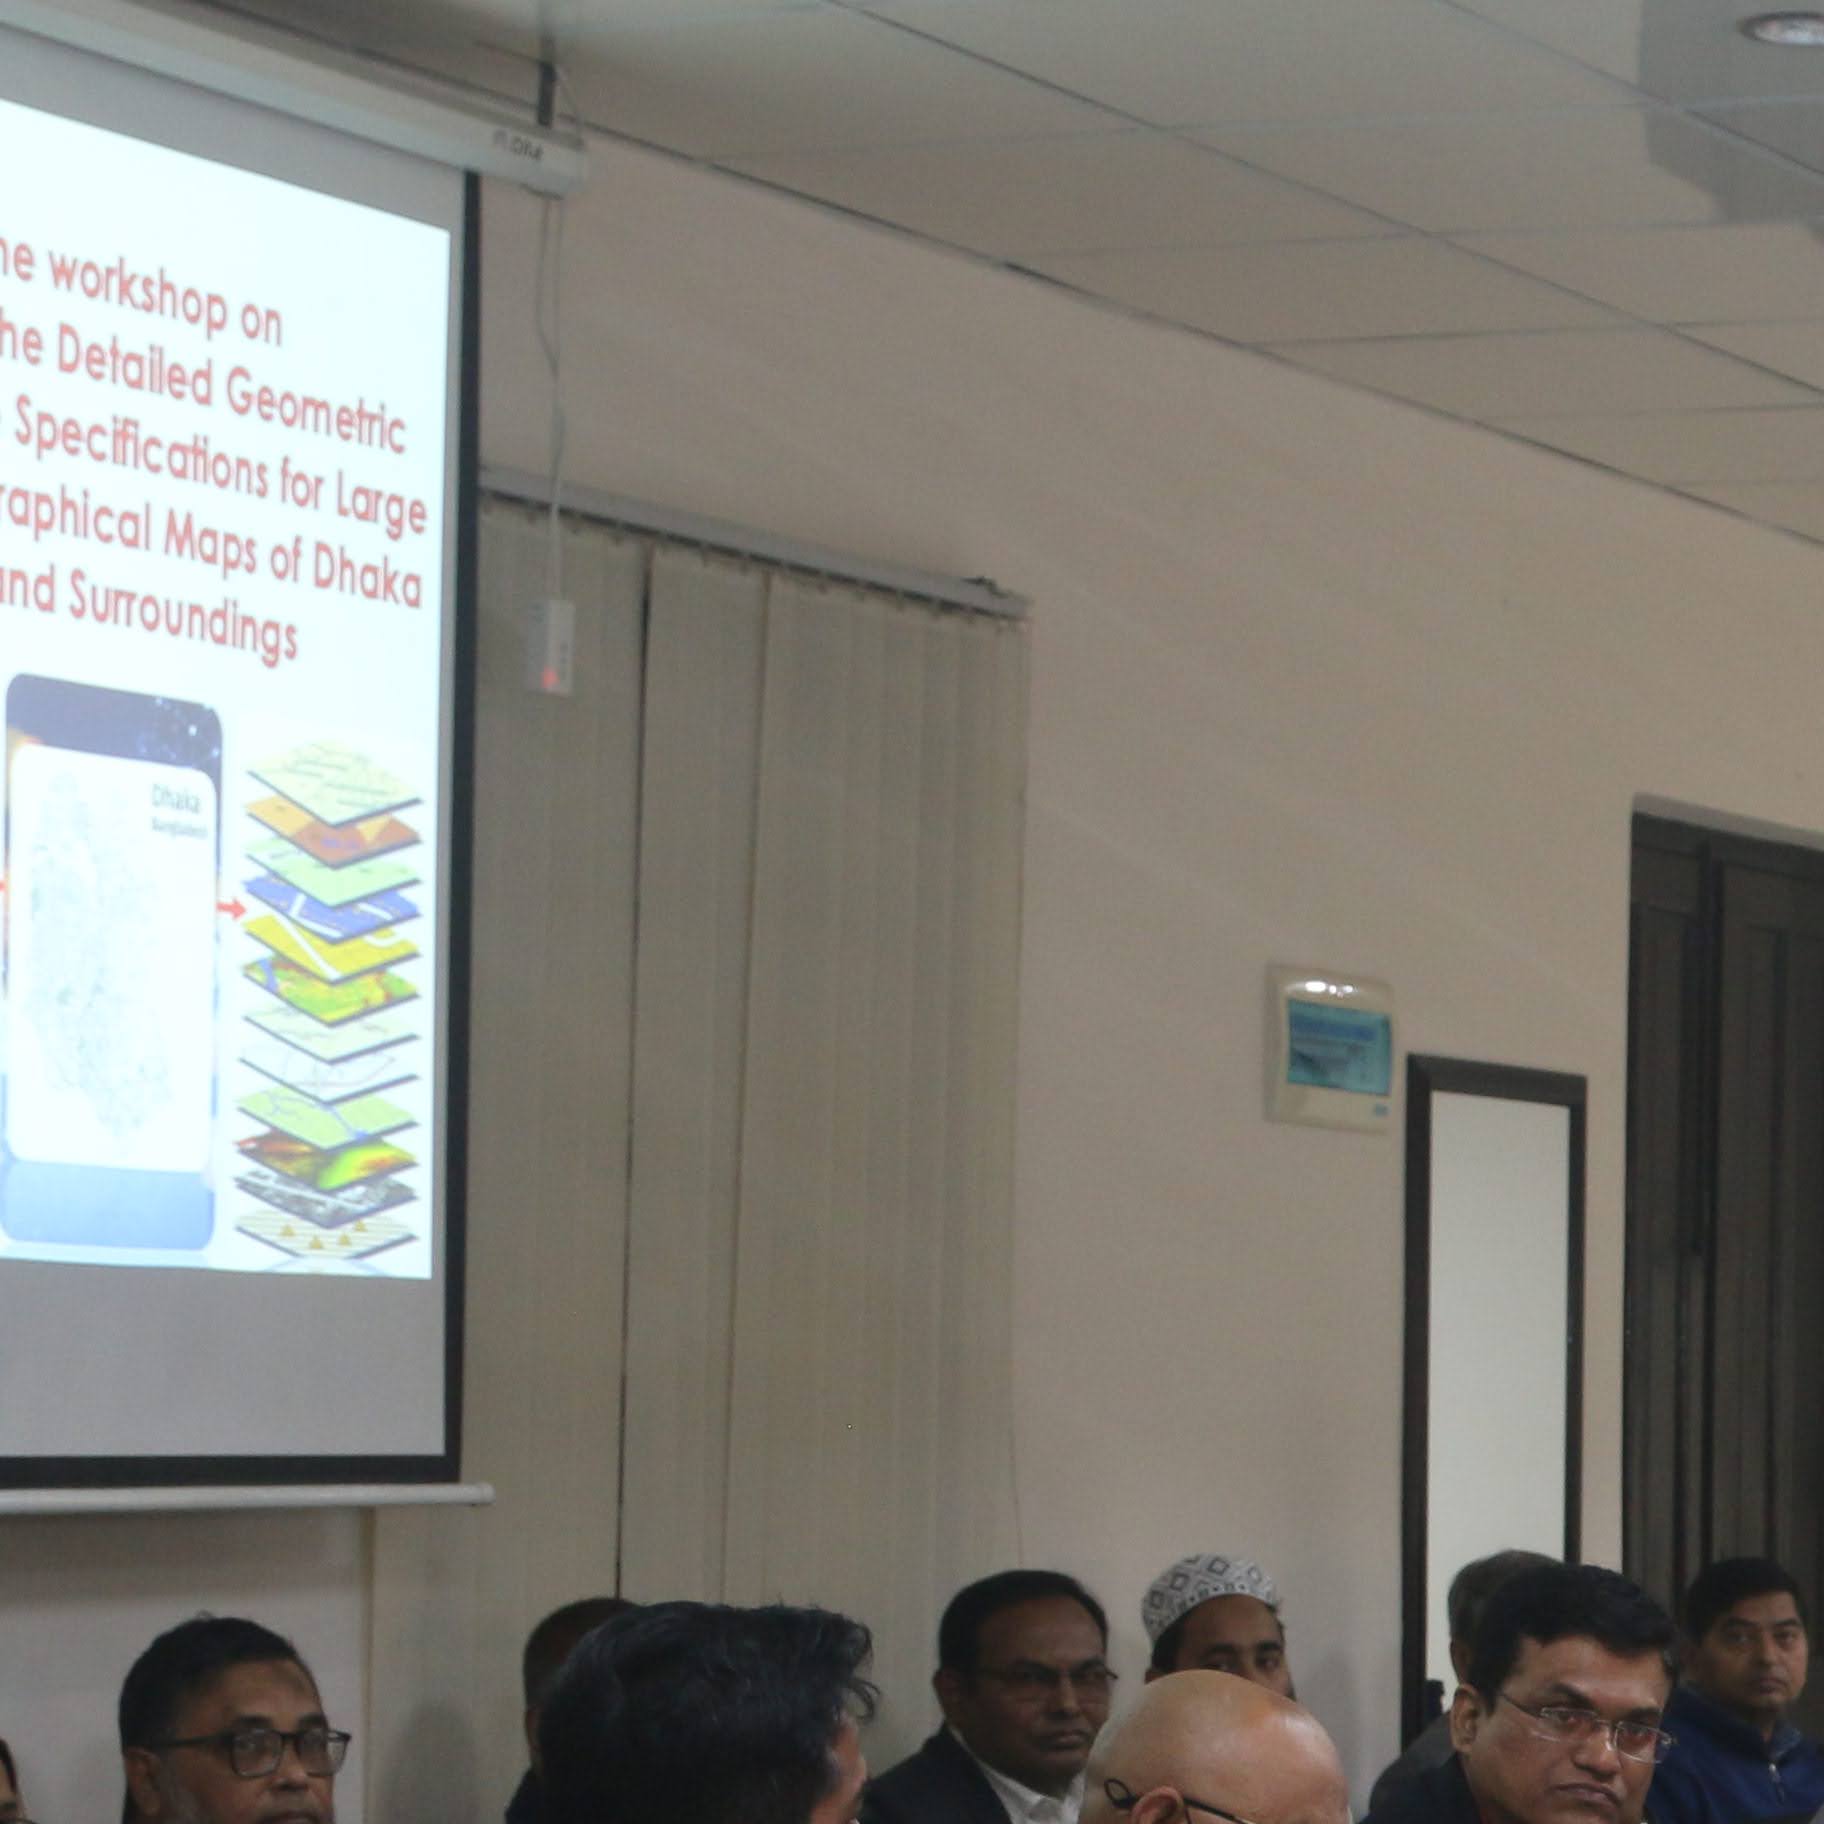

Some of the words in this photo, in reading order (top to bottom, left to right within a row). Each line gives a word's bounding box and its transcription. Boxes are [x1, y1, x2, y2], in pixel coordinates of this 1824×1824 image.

[48, 250, 227, 340] workshop
[241, 302, 282, 346] on
[58, 322, 213, 406] Detailed
[227, 366, 407, 454] Geometric
[15, 394, 269, 499] Specifications
[281, 455, 325, 508] for
[338, 469, 428, 541] Large
[164, 507, 258, 580] Maps
[271, 535, 303, 582] of
[314, 541, 423, 609] Dhaka
[70, 568, 299, 669] Surroundings
